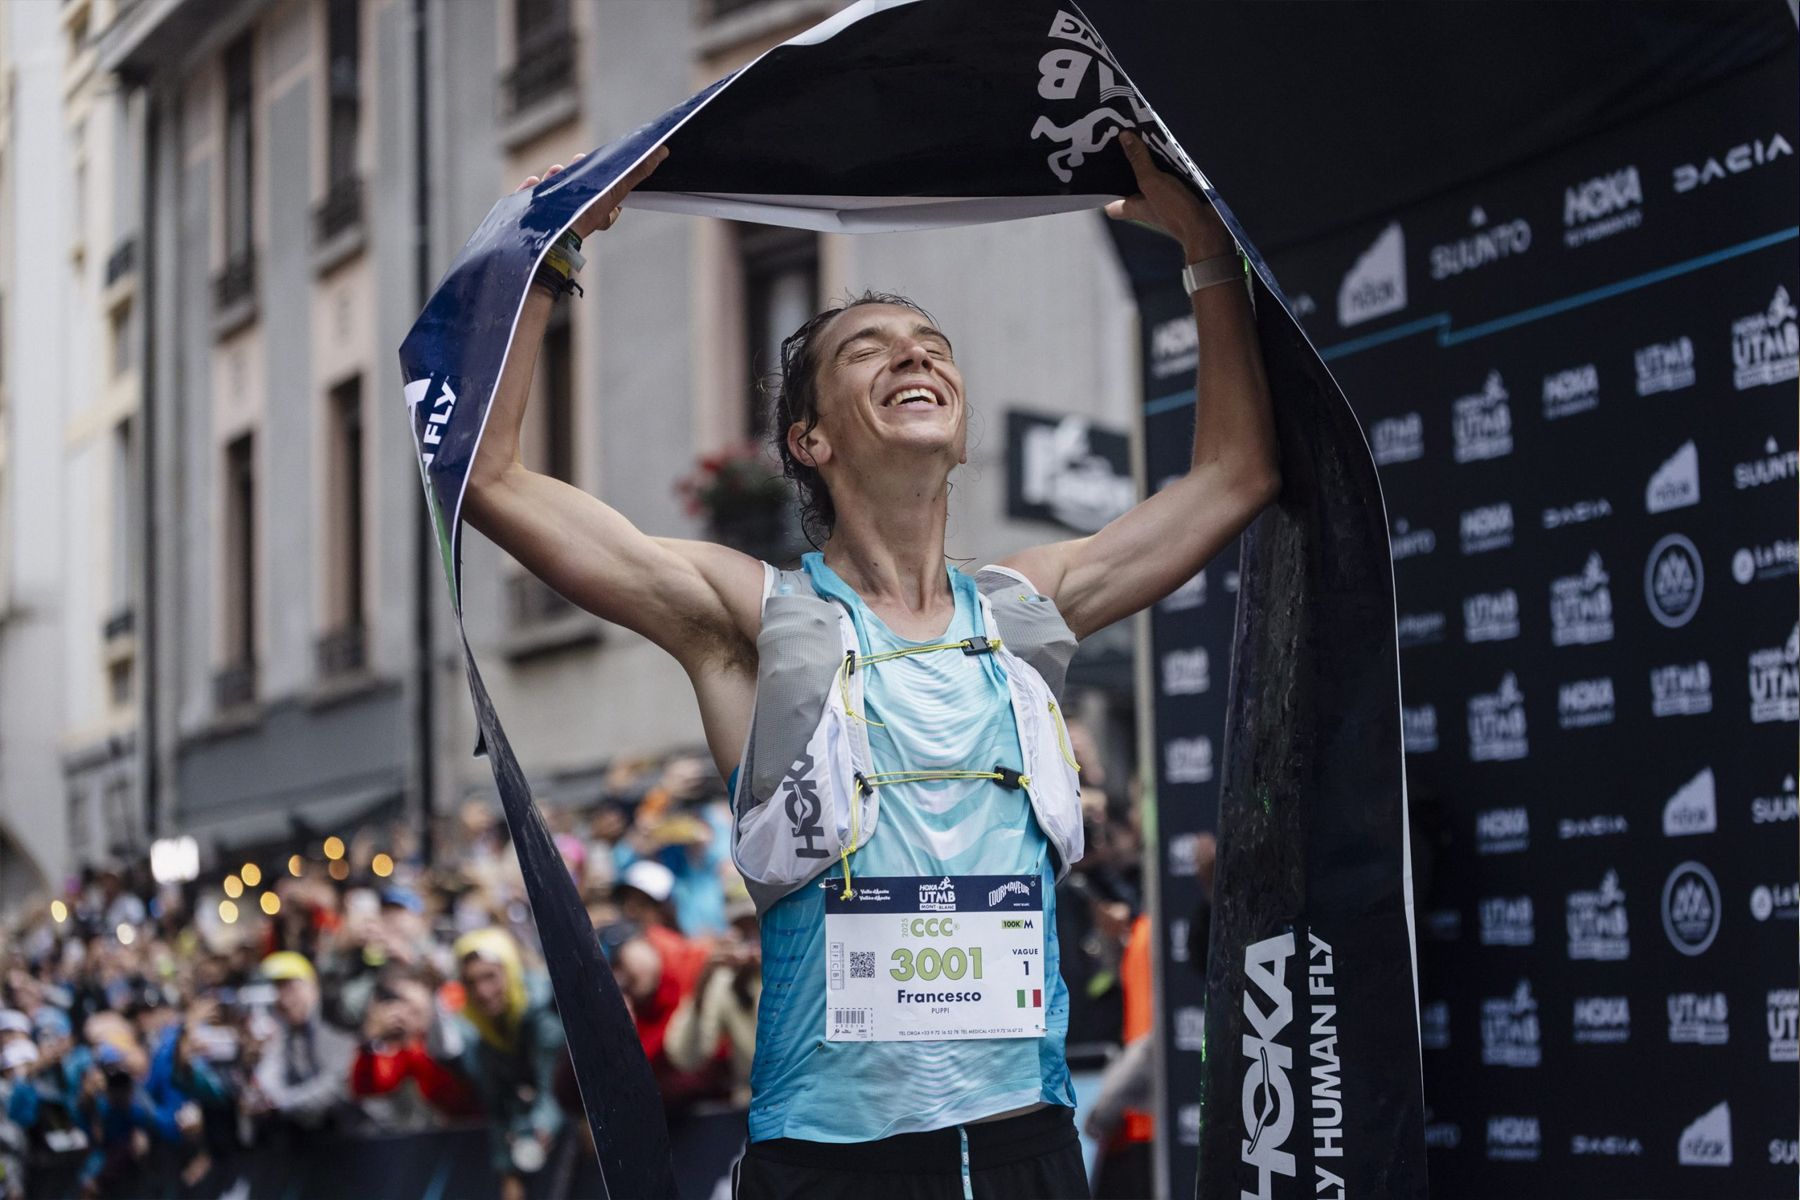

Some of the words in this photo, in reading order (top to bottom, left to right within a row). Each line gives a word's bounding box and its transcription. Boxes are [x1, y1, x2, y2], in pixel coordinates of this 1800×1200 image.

[1672, 132, 1795, 194] DACIA
[423, 381, 456, 445] FLY
[1733, 451, 1799, 489] SUUNT
[1749, 665, 1799, 700] UTM
[783, 754, 830, 859] HOK
[919, 891, 956, 903] UTMB
[988, 880, 1030, 907] COURMAYEUR
[1003, 920, 1020, 928] 100K
[889, 947, 983, 981] 3001
[1023, 961, 1029, 975] 1
[1307, 932, 1335, 996] FLY
[897, 990, 982, 1003] Francesco
[1767, 1008, 1799, 1040] UT
[1241, 931, 1296, 1200] HOKA
[1309, 1004, 1344, 1157] HUMAN
[1315, 1165, 1345, 1200] LY
